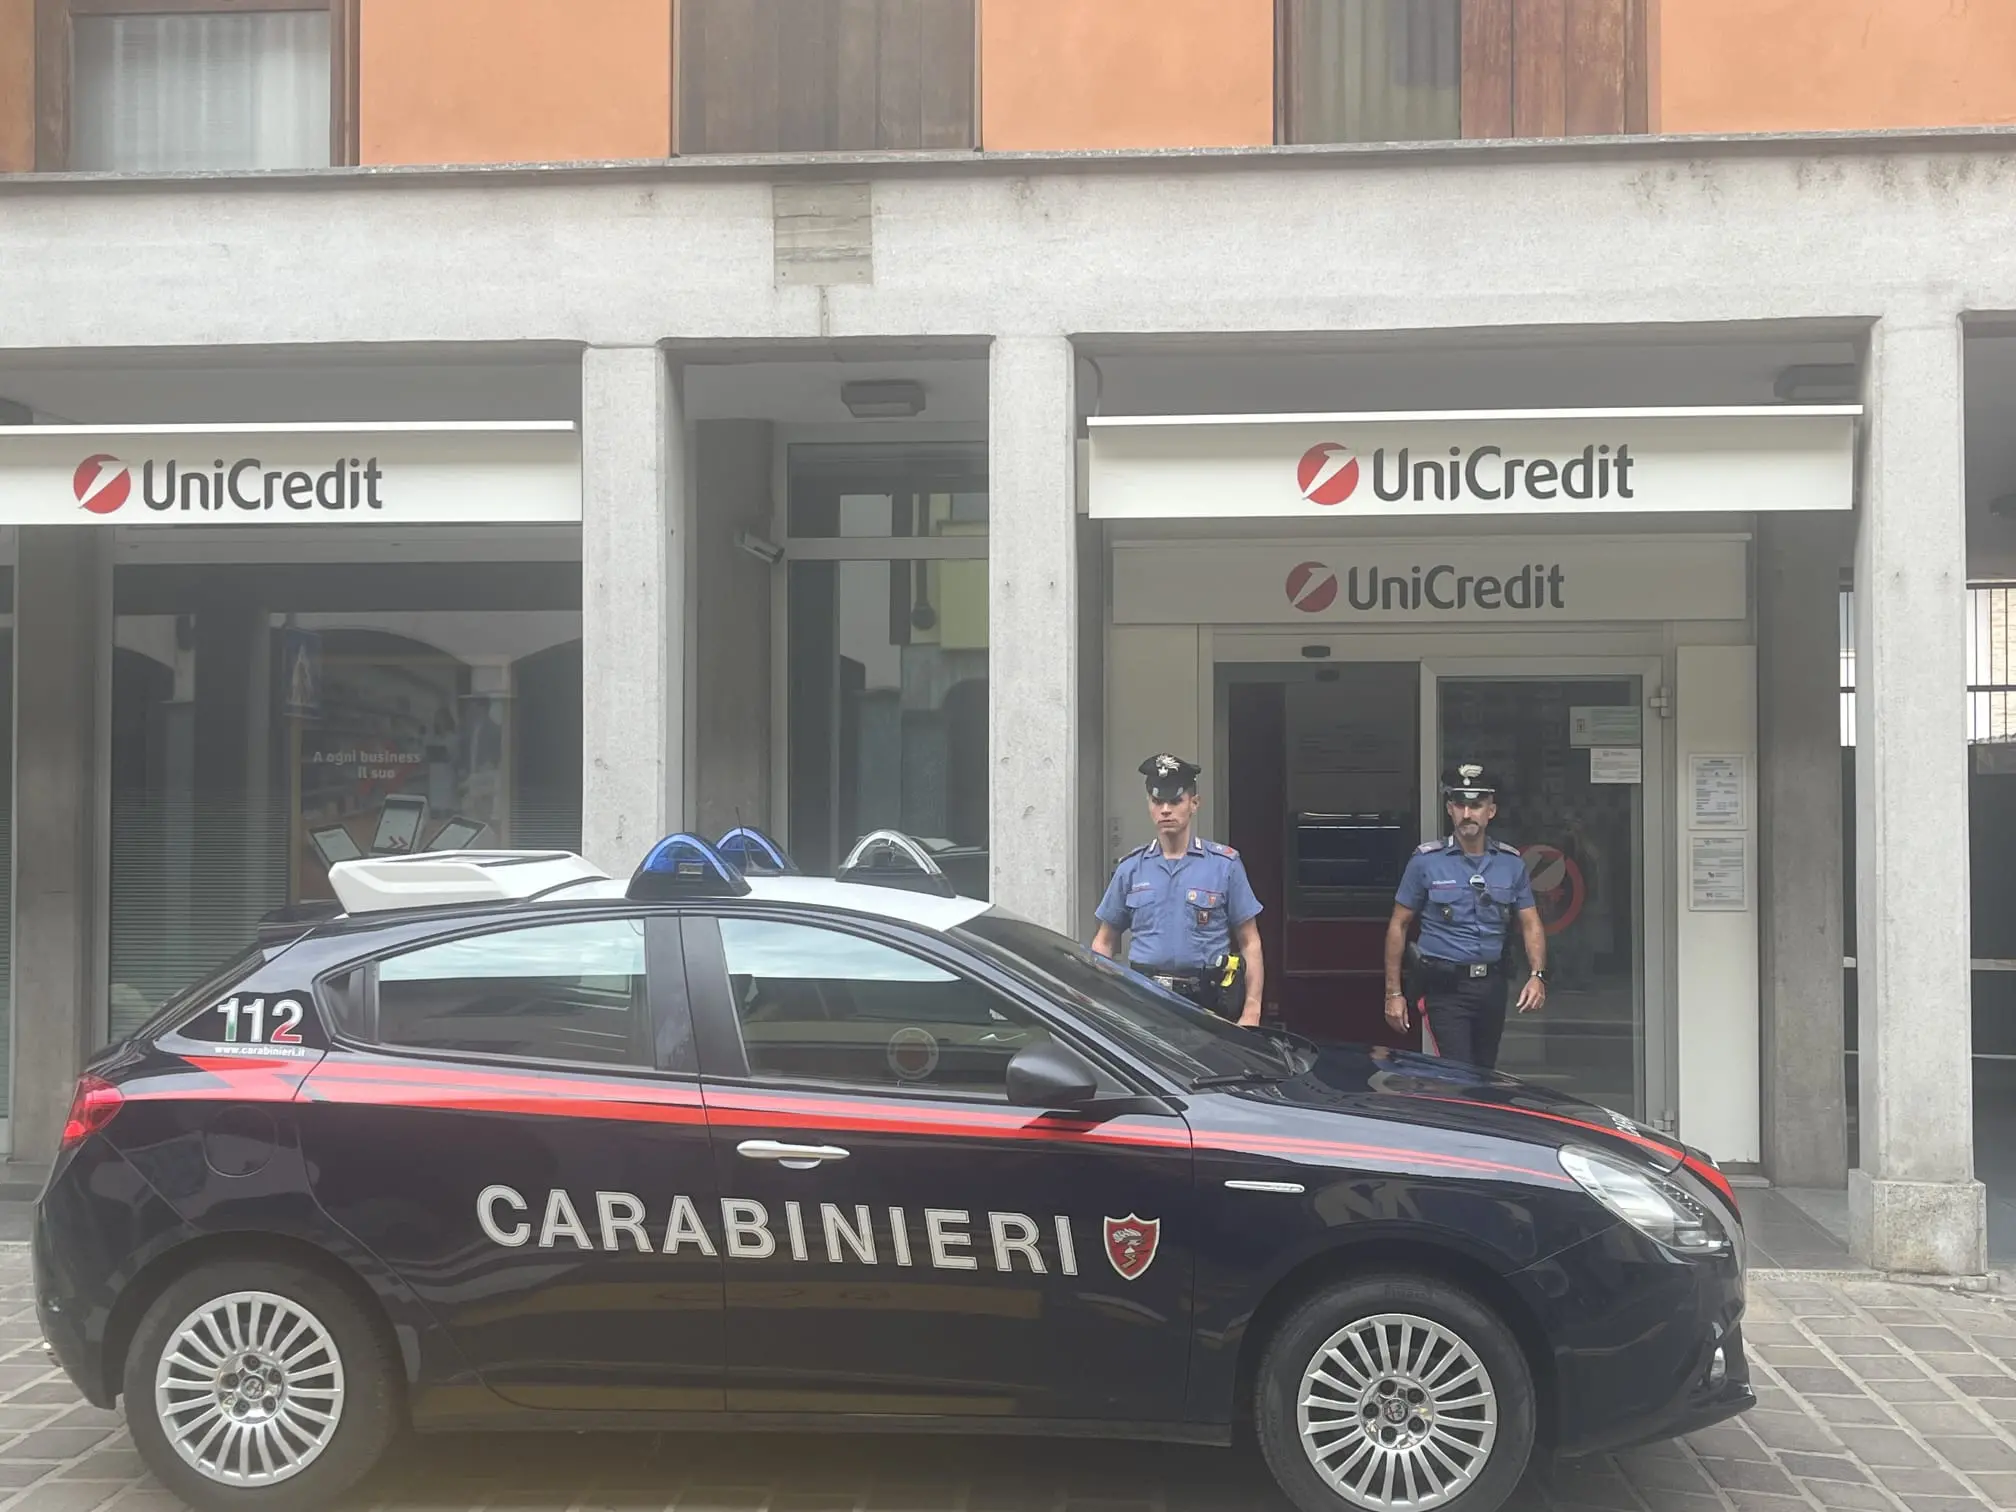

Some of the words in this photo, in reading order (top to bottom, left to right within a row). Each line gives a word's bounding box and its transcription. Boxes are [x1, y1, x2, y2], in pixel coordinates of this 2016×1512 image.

[142, 456, 383, 511] UniCredit
[1373, 443, 1634, 502] UniCredit
[1348, 563, 1565, 611] UniCredit
[313, 751, 323, 762] A
[326, 750, 356, 766] ogni
[361, 750, 421, 763] business
[370, 769, 395, 779] suo
[216, 997, 304, 1044] 112
[213, 1045, 306, 1057] www.carabinieri.it
[476, 1184, 1078, 1276] CARABINIERI
